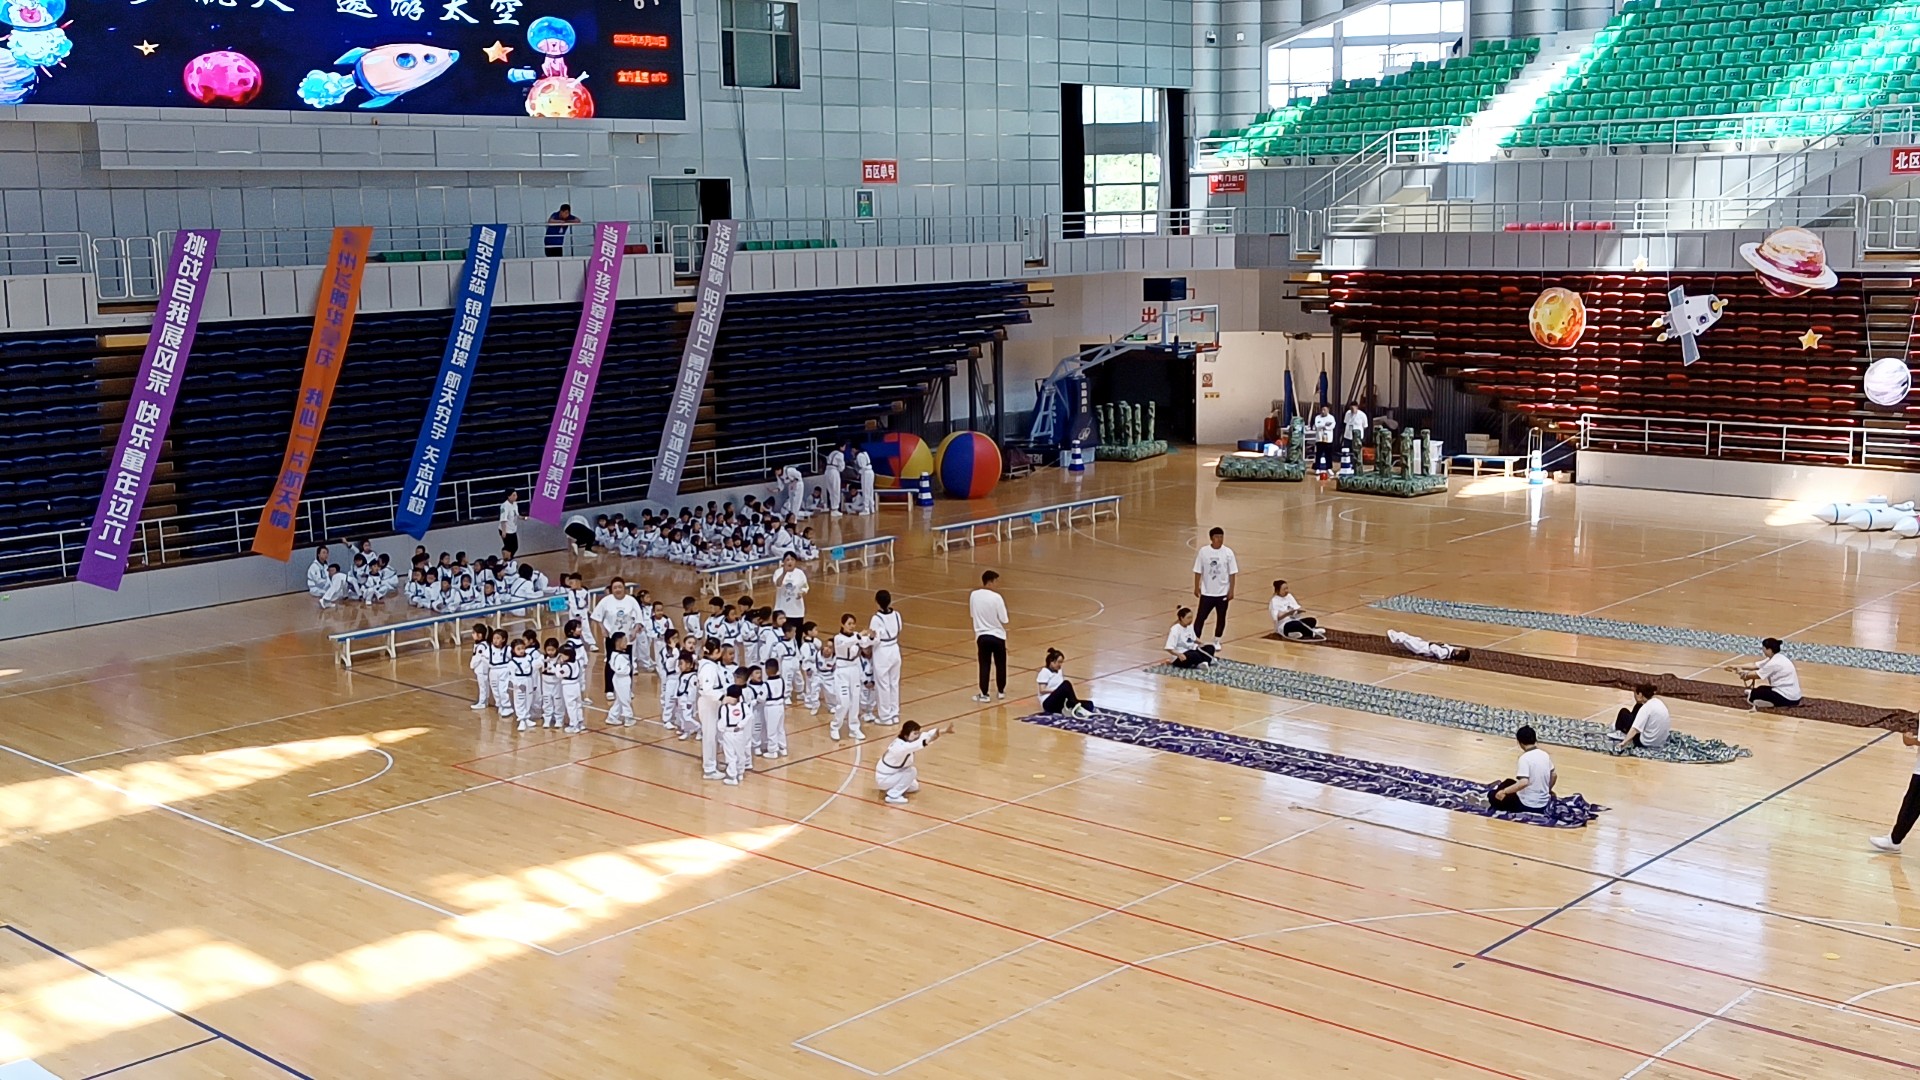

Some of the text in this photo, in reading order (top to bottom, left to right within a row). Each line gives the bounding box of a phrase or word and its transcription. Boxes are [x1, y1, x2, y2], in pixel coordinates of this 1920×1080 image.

[864, 163, 896, 180] 西区单号
[93, 231, 208, 561] 挑战自我展风采 快乐童年过六一
[449, 297, 483, 369] 银河璀璨
[541, 224, 619, 501] 当每个孩子牵手微笑 世界从此变得美好
[658, 221, 732, 485] 活泼聪颖 阳光向上 勇敢当先 超越自我
[268, 387, 324, 530] 我心一片航天情
